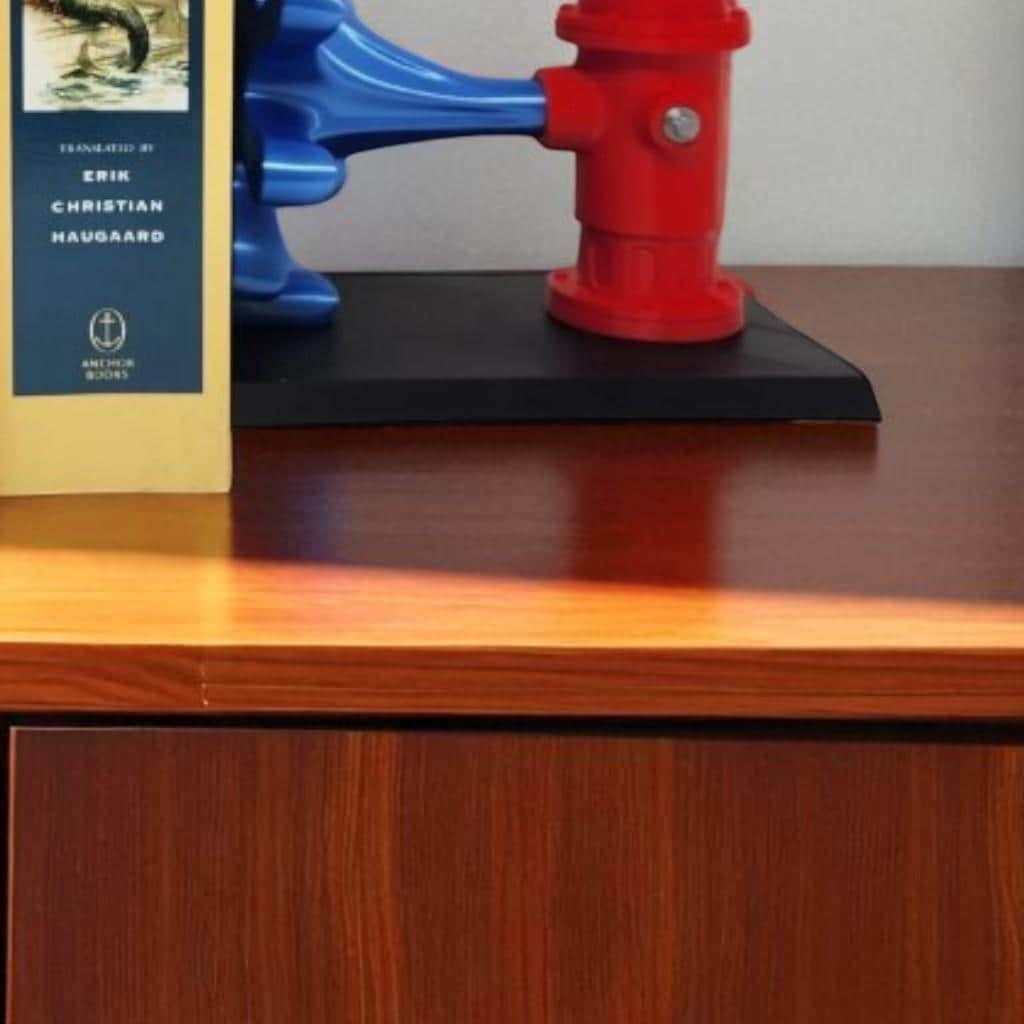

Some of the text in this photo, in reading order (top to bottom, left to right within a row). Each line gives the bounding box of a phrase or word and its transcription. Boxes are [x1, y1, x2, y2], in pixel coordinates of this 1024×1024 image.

[81, 169, 131, 183] ERIK
[50, 199, 164, 214] CHRISTIAN
[51, 229, 166, 244] HAUGAARD
